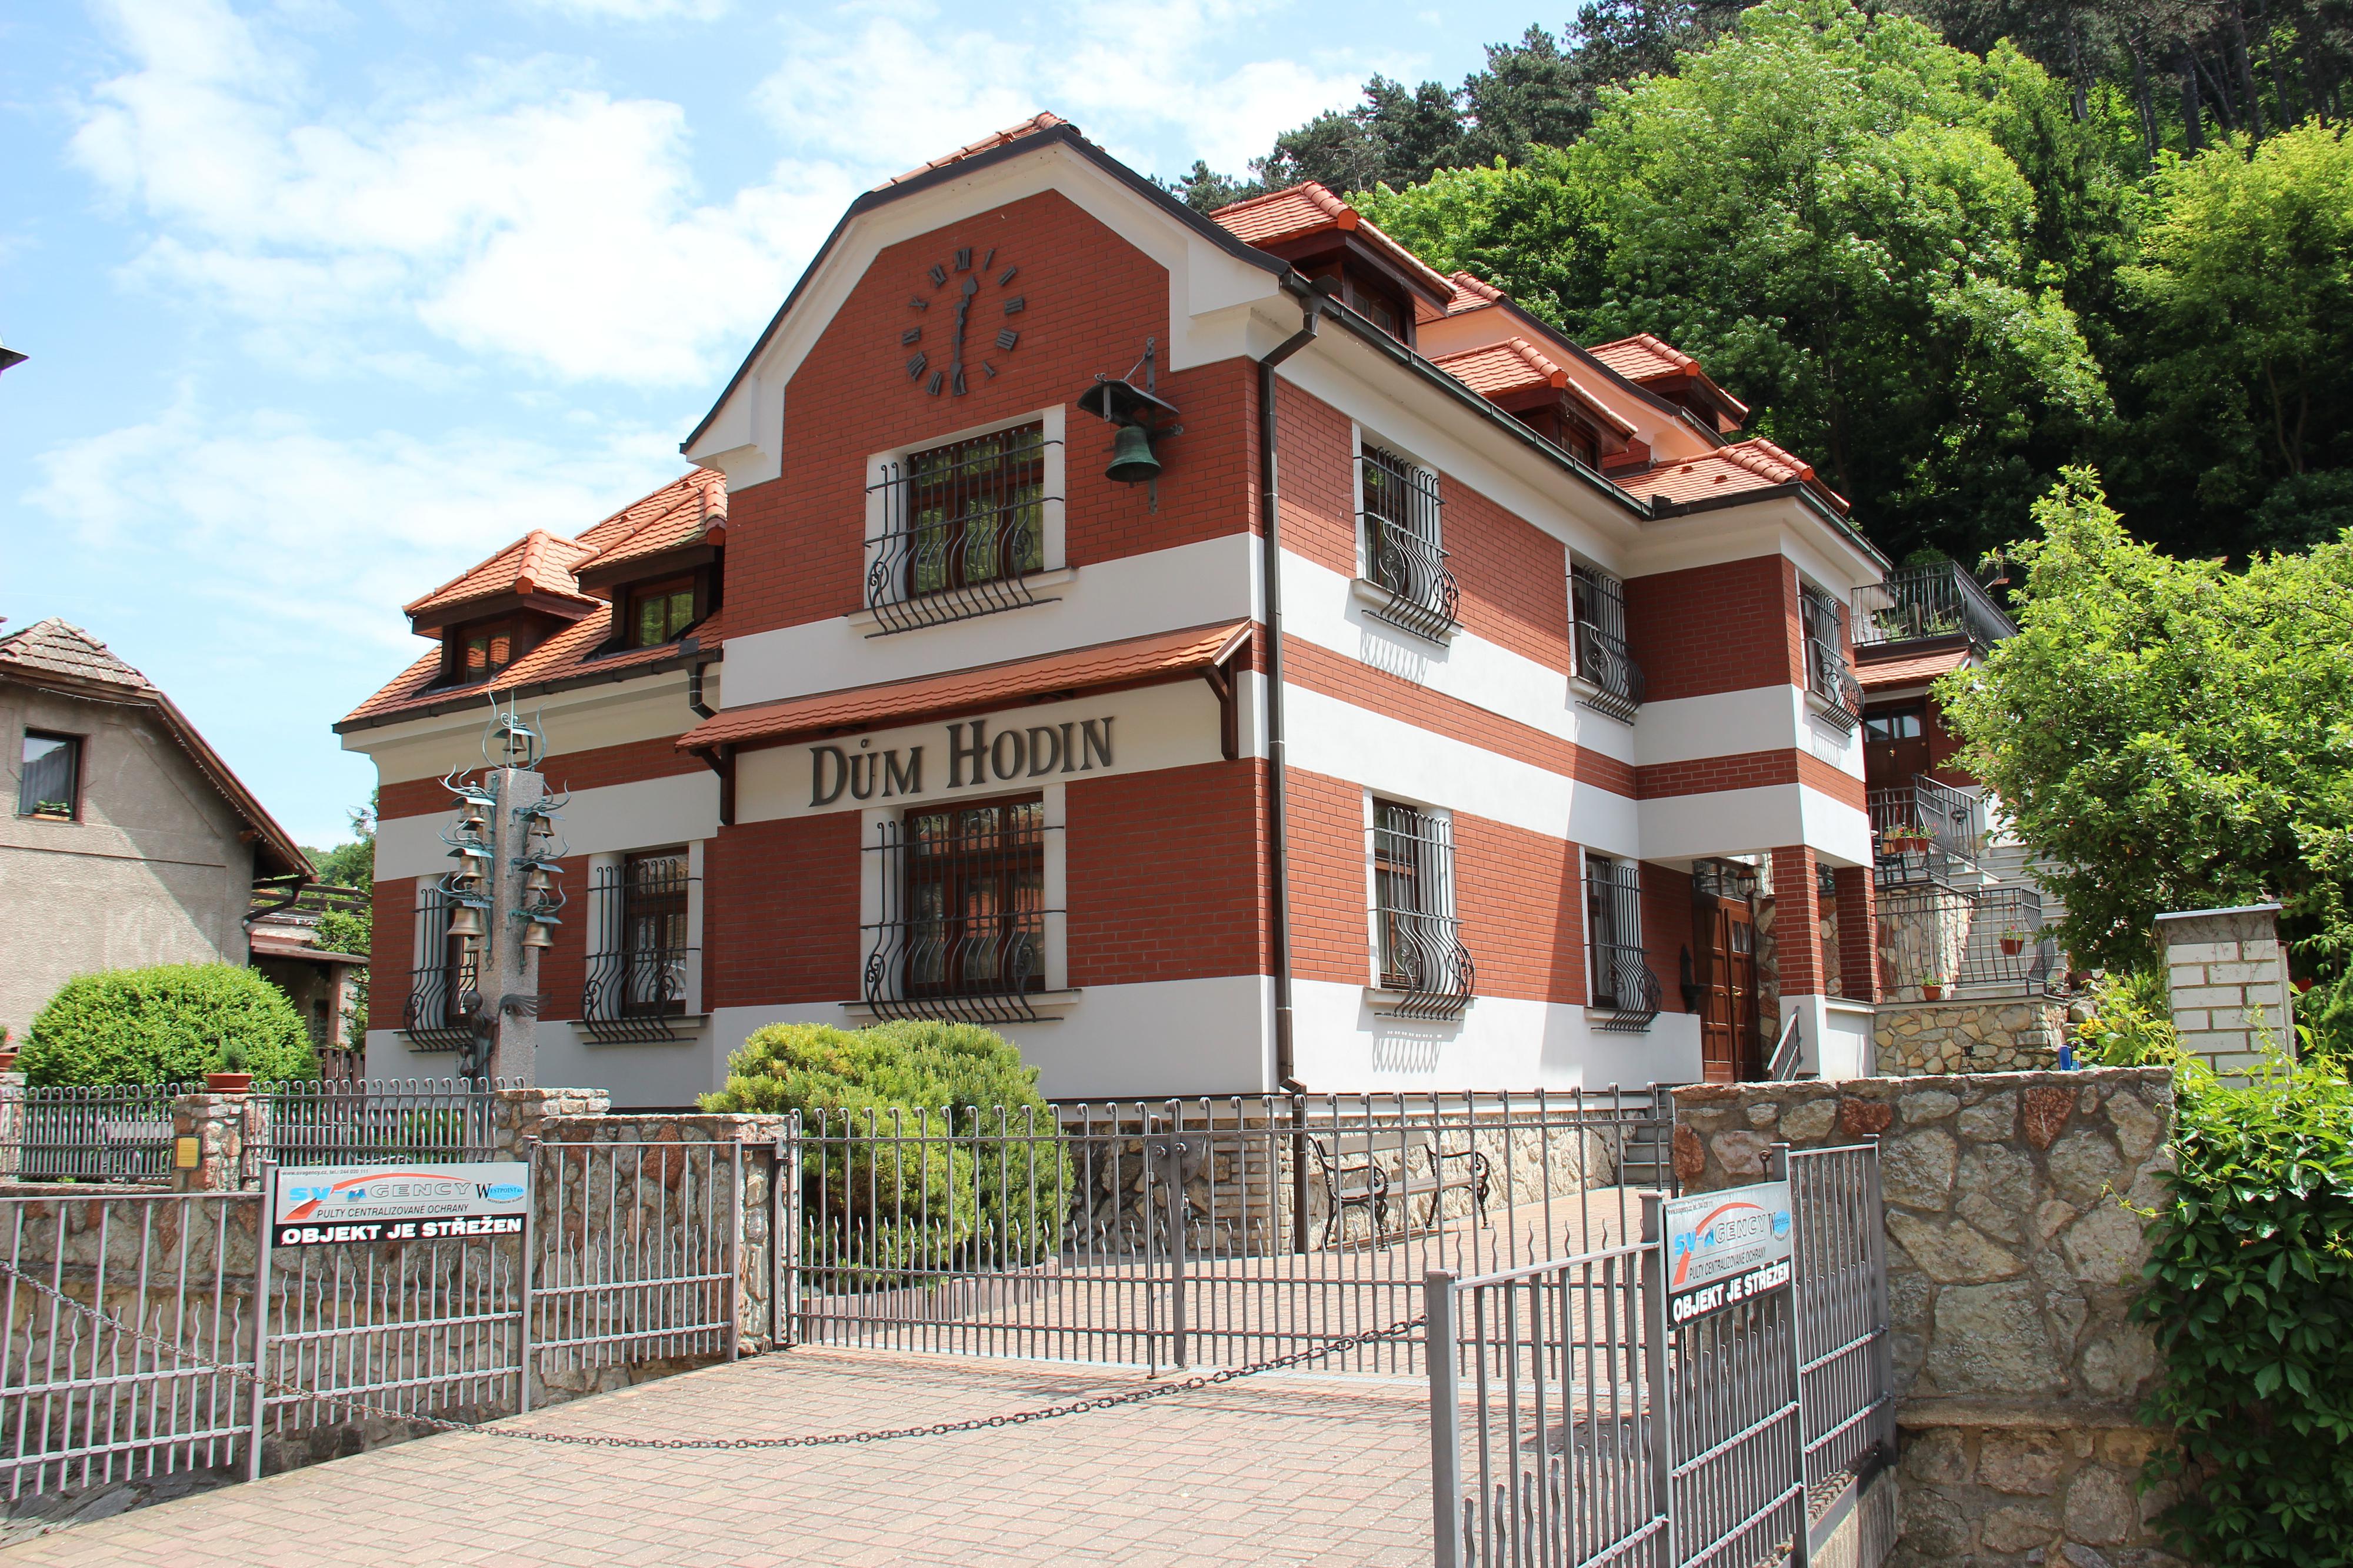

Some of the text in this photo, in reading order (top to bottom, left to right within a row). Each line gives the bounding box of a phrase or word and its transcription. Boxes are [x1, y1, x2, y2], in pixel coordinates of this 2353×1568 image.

[954, 248, 971, 272] XII
[928, 264, 946, 287] XI
[998, 265, 1016, 286] II
[909, 296, 928, 311] X
[1005, 296, 1024, 315] III
[902, 327, 921, 345] IX
[996, 328, 1018, 351] IIII
[906, 352, 926, 381] VIII
[926, 371, 941, 396] VII
[808, 716, 1114, 808] DŮM HODIN
[317, 1203, 469, 1219] PULTY CENTRALIZOVANÉ OCHRANY
[282, 1216, 522, 1245] OBJEKT JE STŘEŽEN
[1689, 1246, 1767, 1281] PULTY CENTRALIZOVANÉ OCHRANY
[1672, 1260, 1789, 1322] OBJEKT JE STŘEŽEN
